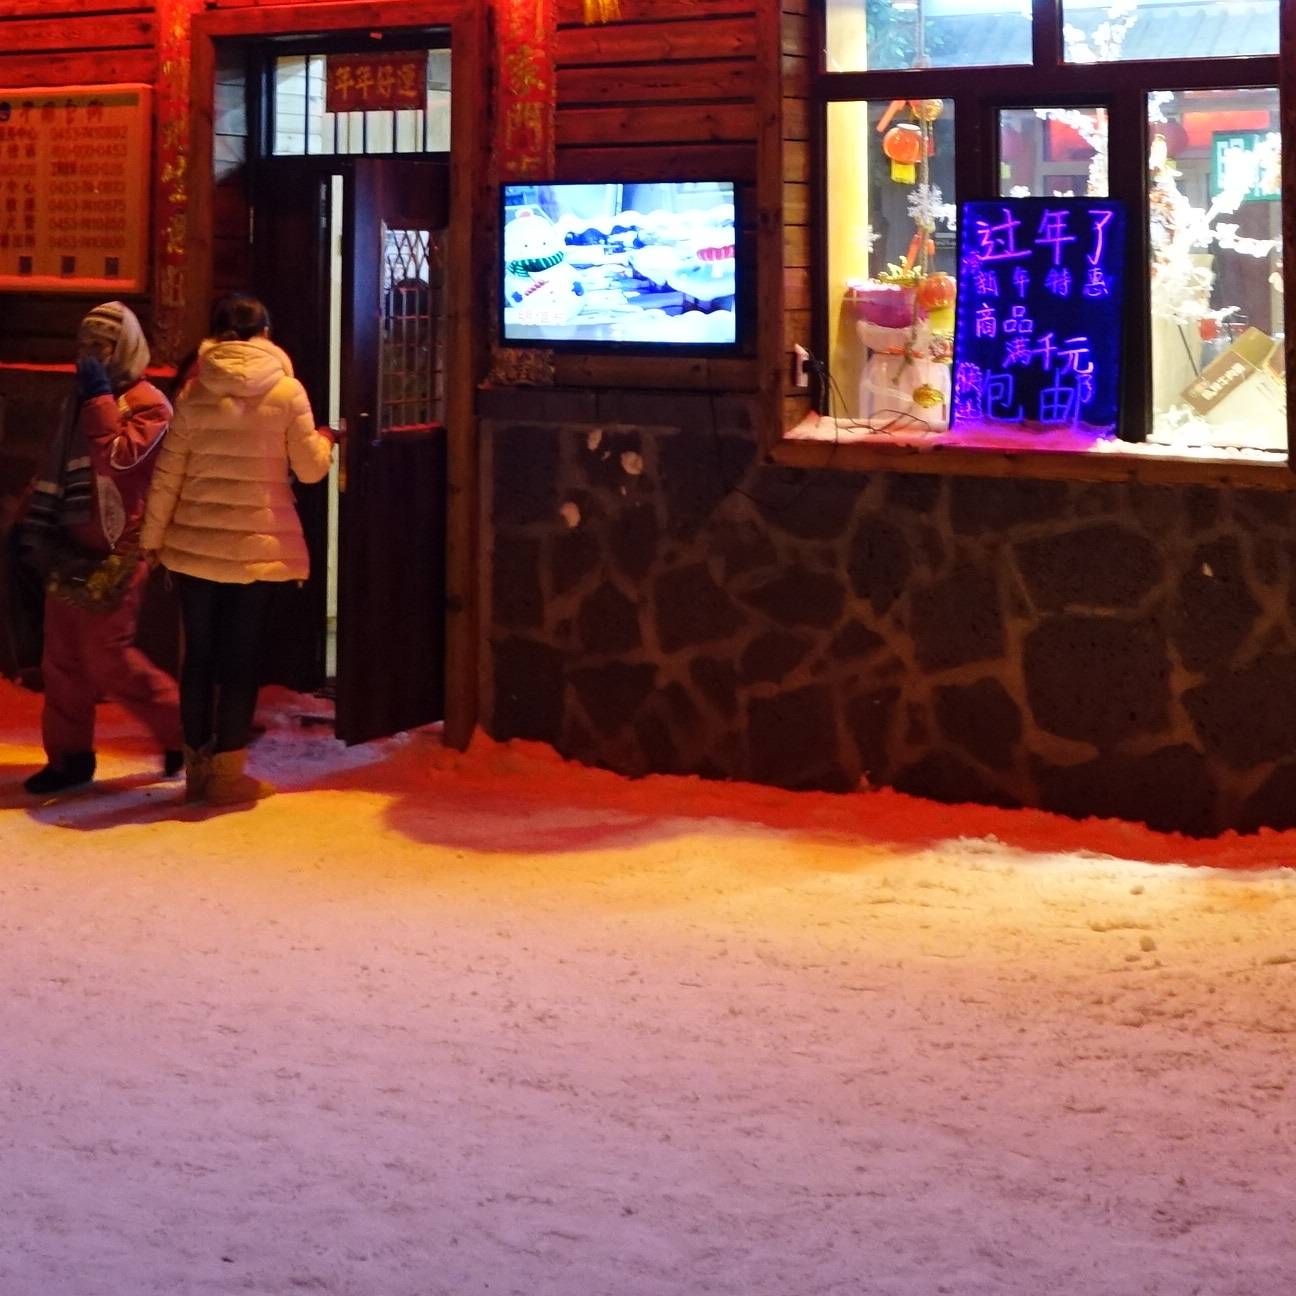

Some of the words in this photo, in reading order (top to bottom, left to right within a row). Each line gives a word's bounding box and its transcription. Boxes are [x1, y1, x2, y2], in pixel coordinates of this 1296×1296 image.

[974, 208, 1114, 265] 过年了
[975, 302, 1034, 338] 商品
[985, 369, 1094, 426] 包邮
